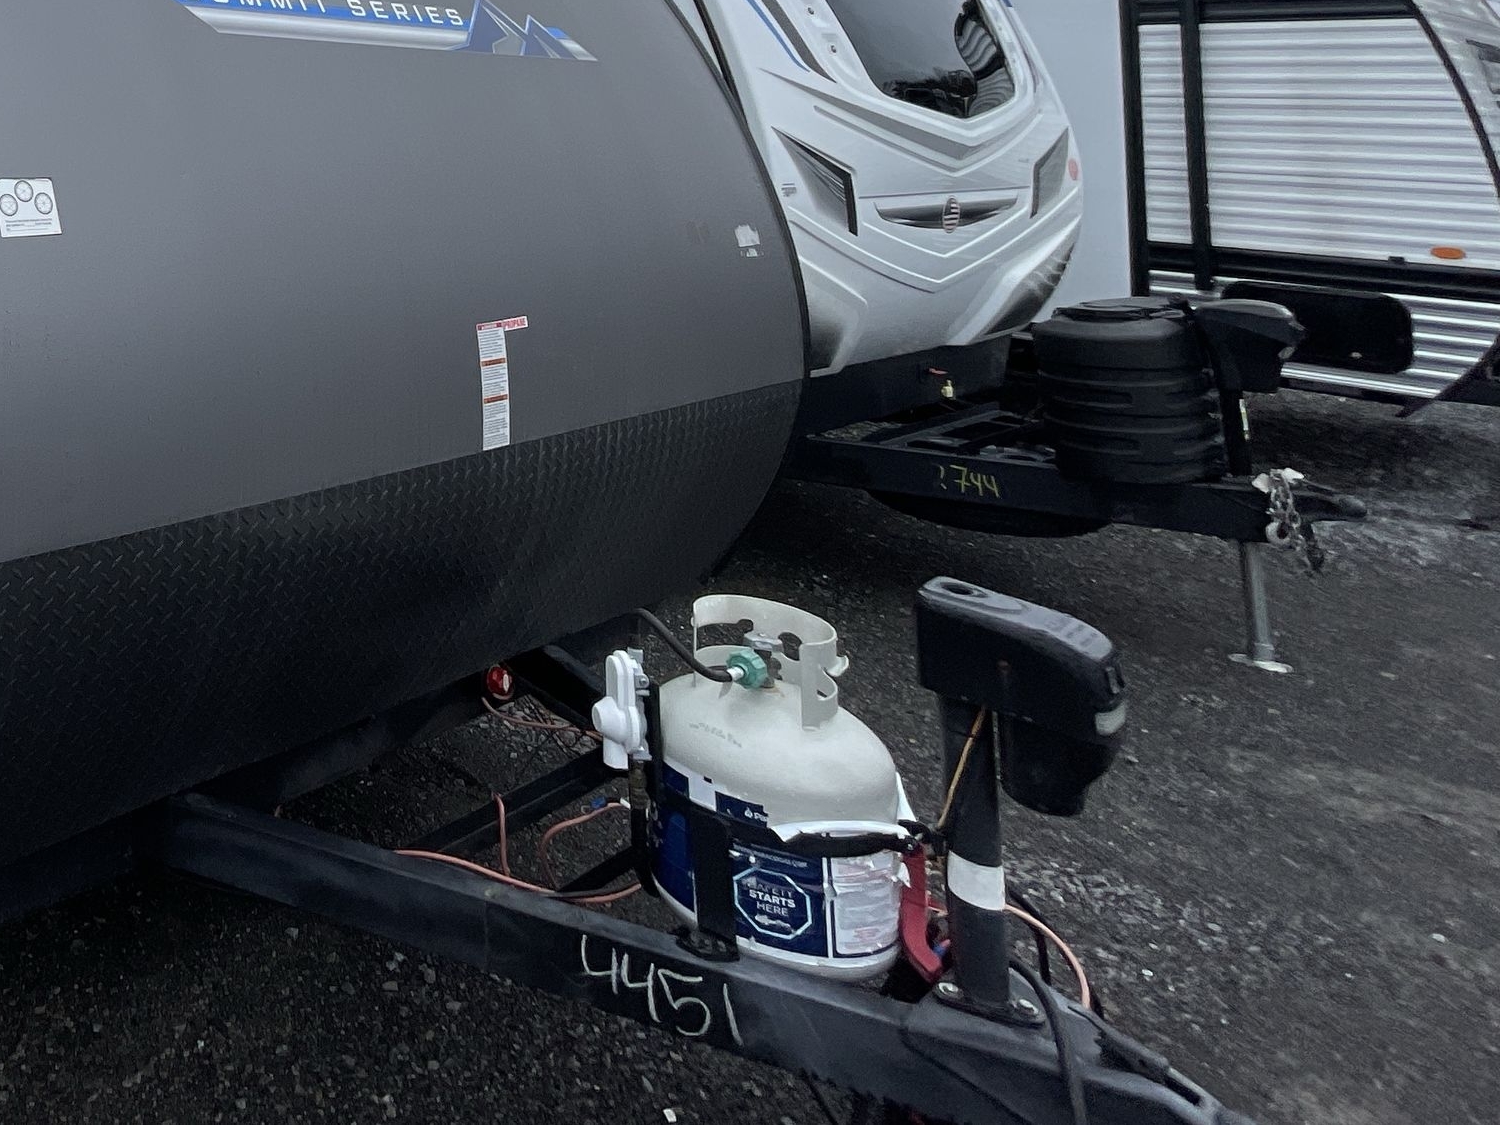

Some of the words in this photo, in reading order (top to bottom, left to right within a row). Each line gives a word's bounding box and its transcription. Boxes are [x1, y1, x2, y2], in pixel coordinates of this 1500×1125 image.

[749, 889, 796, 908] STARTS
[756, 901, 789, 917] HERE
[581, 934, 743, 1047] 4451
